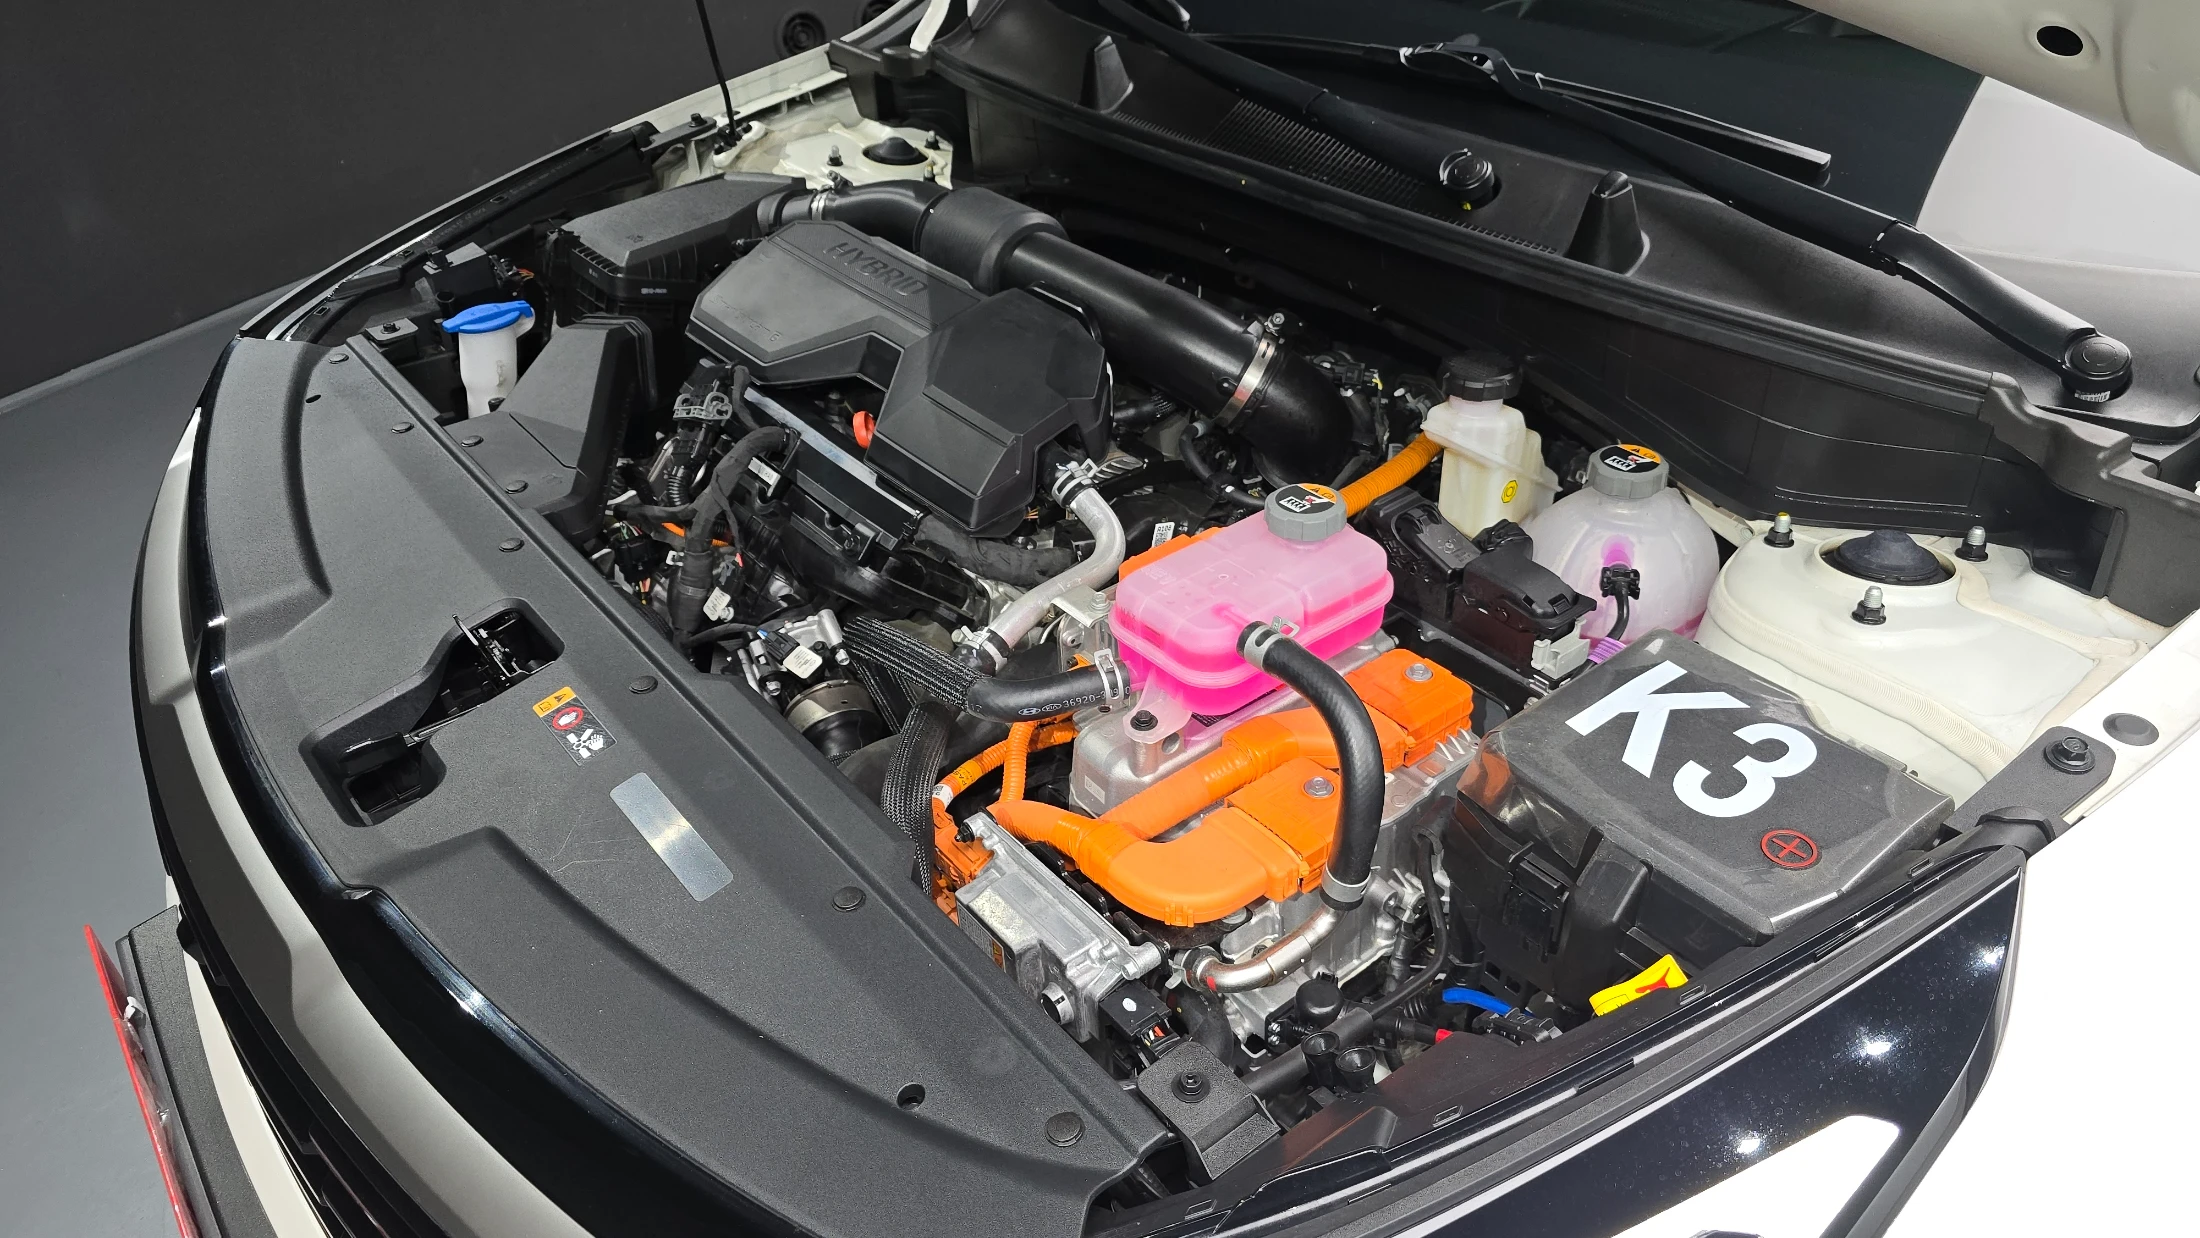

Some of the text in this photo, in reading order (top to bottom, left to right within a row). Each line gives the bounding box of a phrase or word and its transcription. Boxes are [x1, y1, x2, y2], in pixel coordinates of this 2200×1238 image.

[823, 242, 928, 296] HYBRID
[1062, 686, 1131, 708] 36920-390
[1565, 660, 1818, 818] K3
